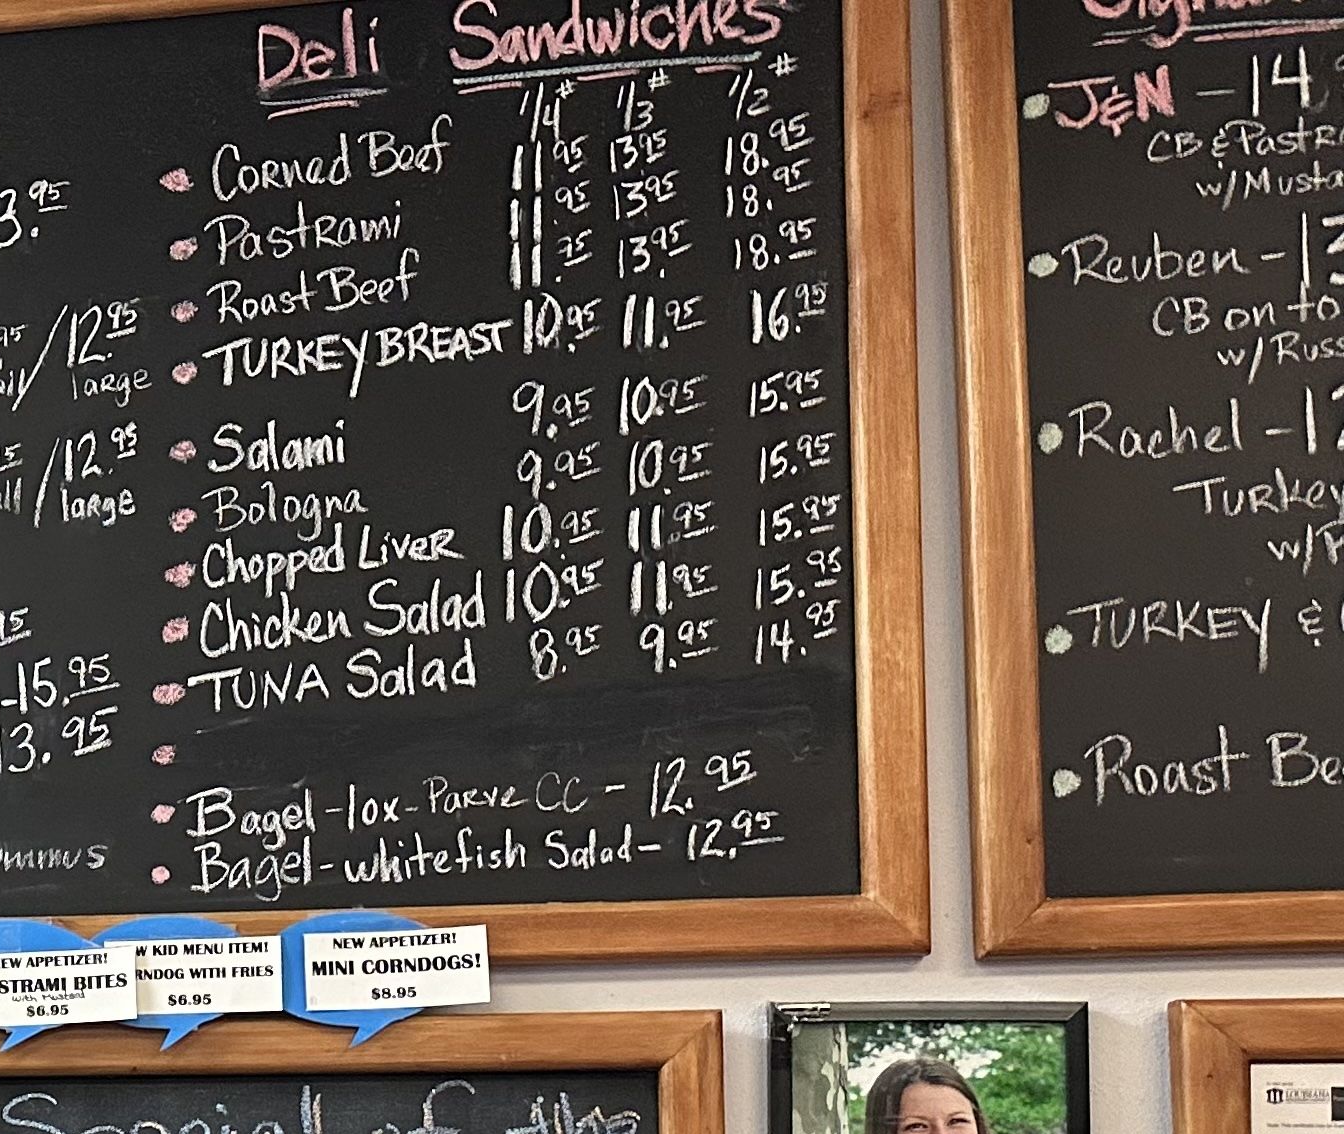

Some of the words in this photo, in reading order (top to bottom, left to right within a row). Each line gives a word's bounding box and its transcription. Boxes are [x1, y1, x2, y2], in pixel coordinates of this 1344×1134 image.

[258, 8, 380, 90] Deli
[1147, 129, 1204, 163] CB
[1061, 231, 1251, 285] Reuben
[207, 265, 320, 325] Roast
[318, 249, 419, 310] Beef
[203, 332, 374, 398] TURKEY
[377, 321, 512, 366] BREAST
[208, 421, 346, 474] Salami
[1068, 400, 1244, 459] Rachel
[201, 482, 368, 540] Bologna
[201, 528, 343, 599] Chopped
[198, 606, 352, 659] Chicken
[365, 569, 486, 638] Salad
[1067, 597, 1270, 674] TURKEY
[185, 671, 329, 713] TUNA
[346, 641, 477, 699] Salad
[26, 953, 108, 968] APPETIZER!
[152, 943, 178, 956] KID
[183, 942, 223, 956] MENU
[228, 941, 268, 954] ITEM!
[312, 960, 358, 977] MINI
[363, 953, 481, 974] CORNDOGS!
[332, 936, 363, 950] NEW
[368, 932, 457, 948] APPETIZER!
[73, 972, 128, 990] BITES
[190, 966, 227, 980] WITH
[232, 964, 274, 978] FRIES
[371, 986, 417, 1000] $8.95
[26, 1002, 69, 1018] $6.95
[168, 993, 212, 1006] $6.95
